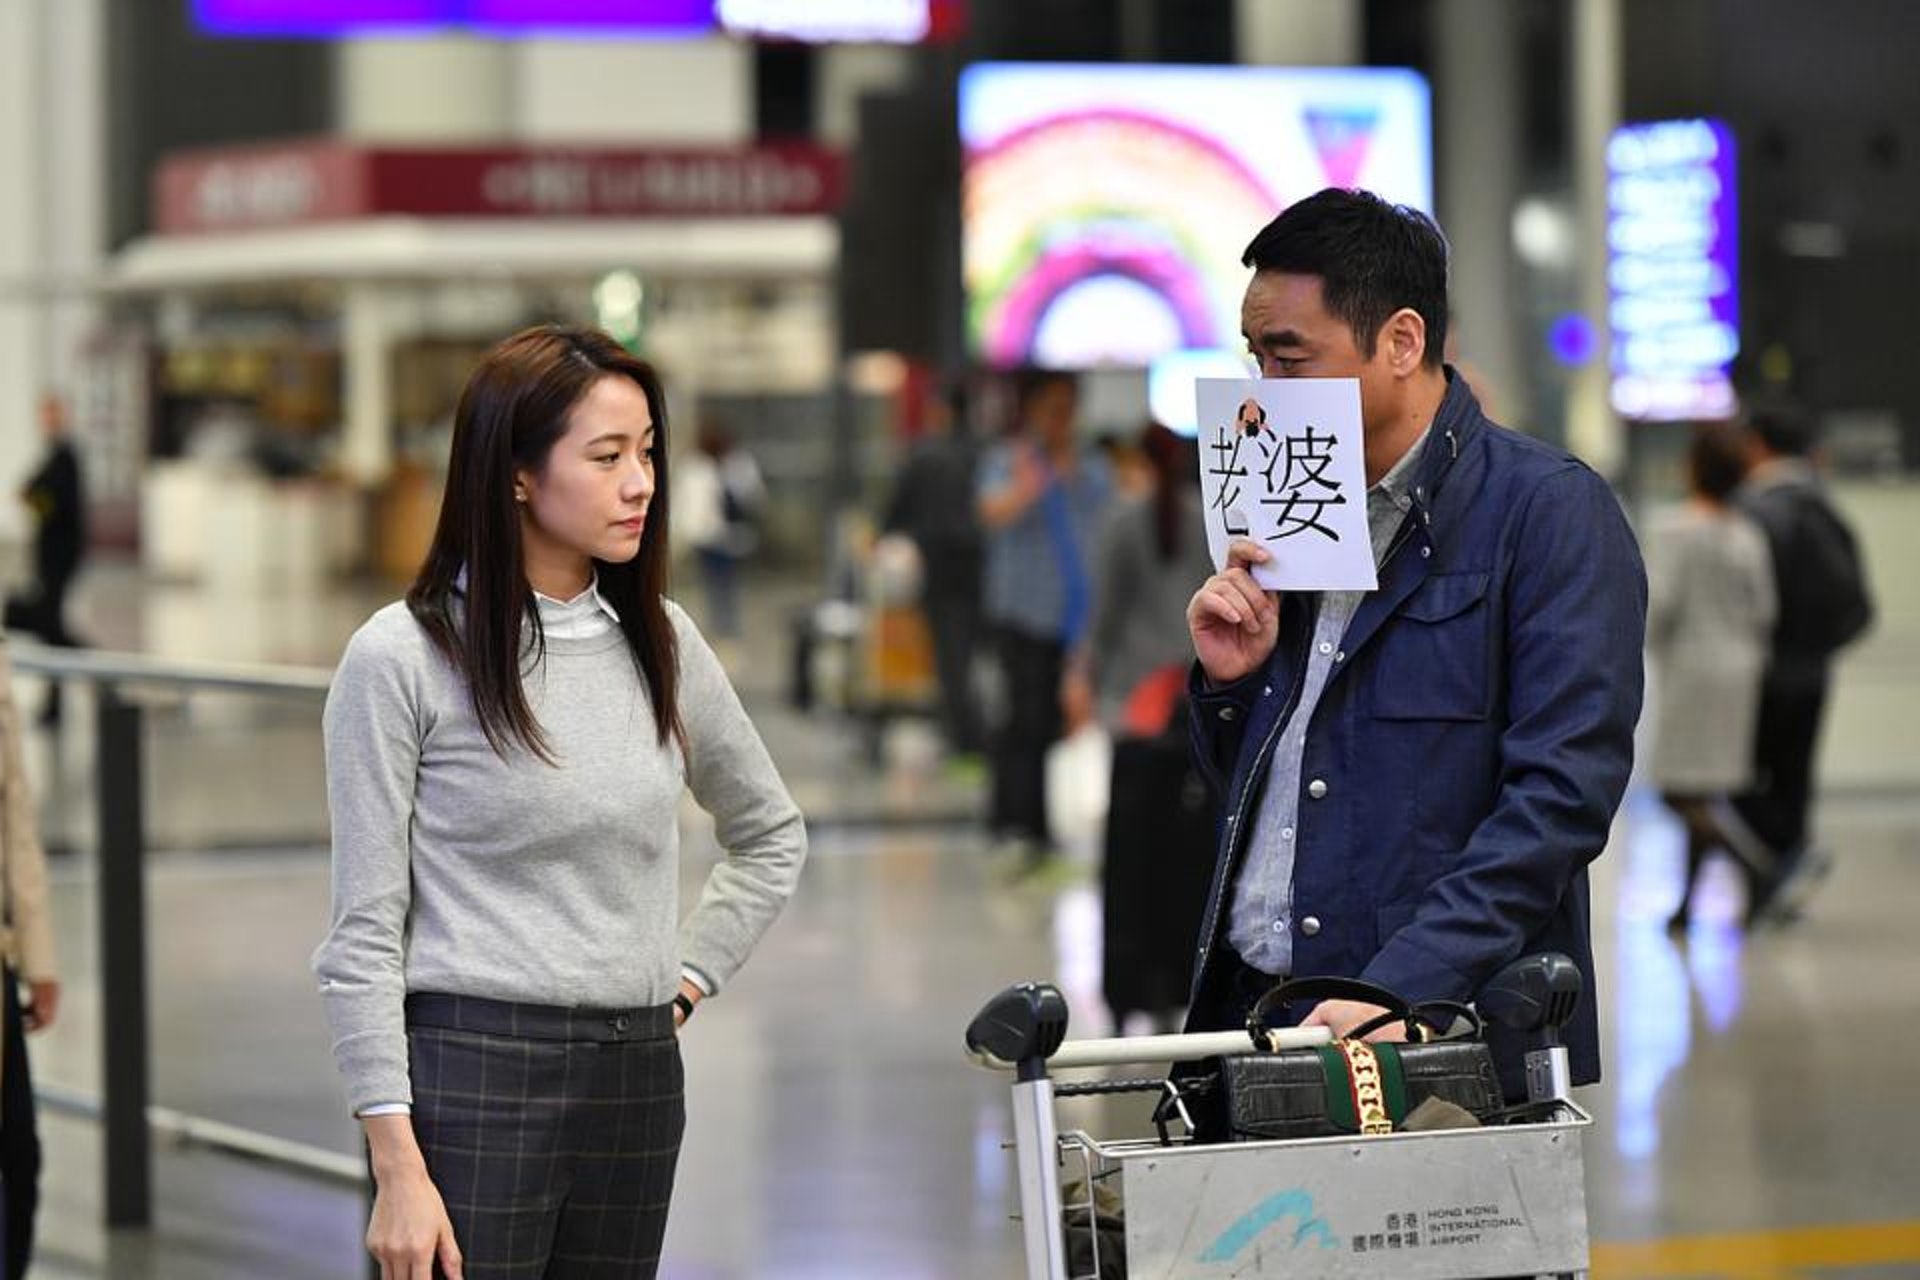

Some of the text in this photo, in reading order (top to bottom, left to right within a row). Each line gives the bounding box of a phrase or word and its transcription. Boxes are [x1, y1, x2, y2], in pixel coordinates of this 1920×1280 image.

[1209, 426, 1346, 541] 老婆
[1427, 1205, 1499, 1218] HONG KONG
[1387, 1212, 1417, 1230] 香港
[1428, 1218, 1523, 1233] INTERNATIONAL
[1430, 1234, 1481, 1245] AIRPORT
